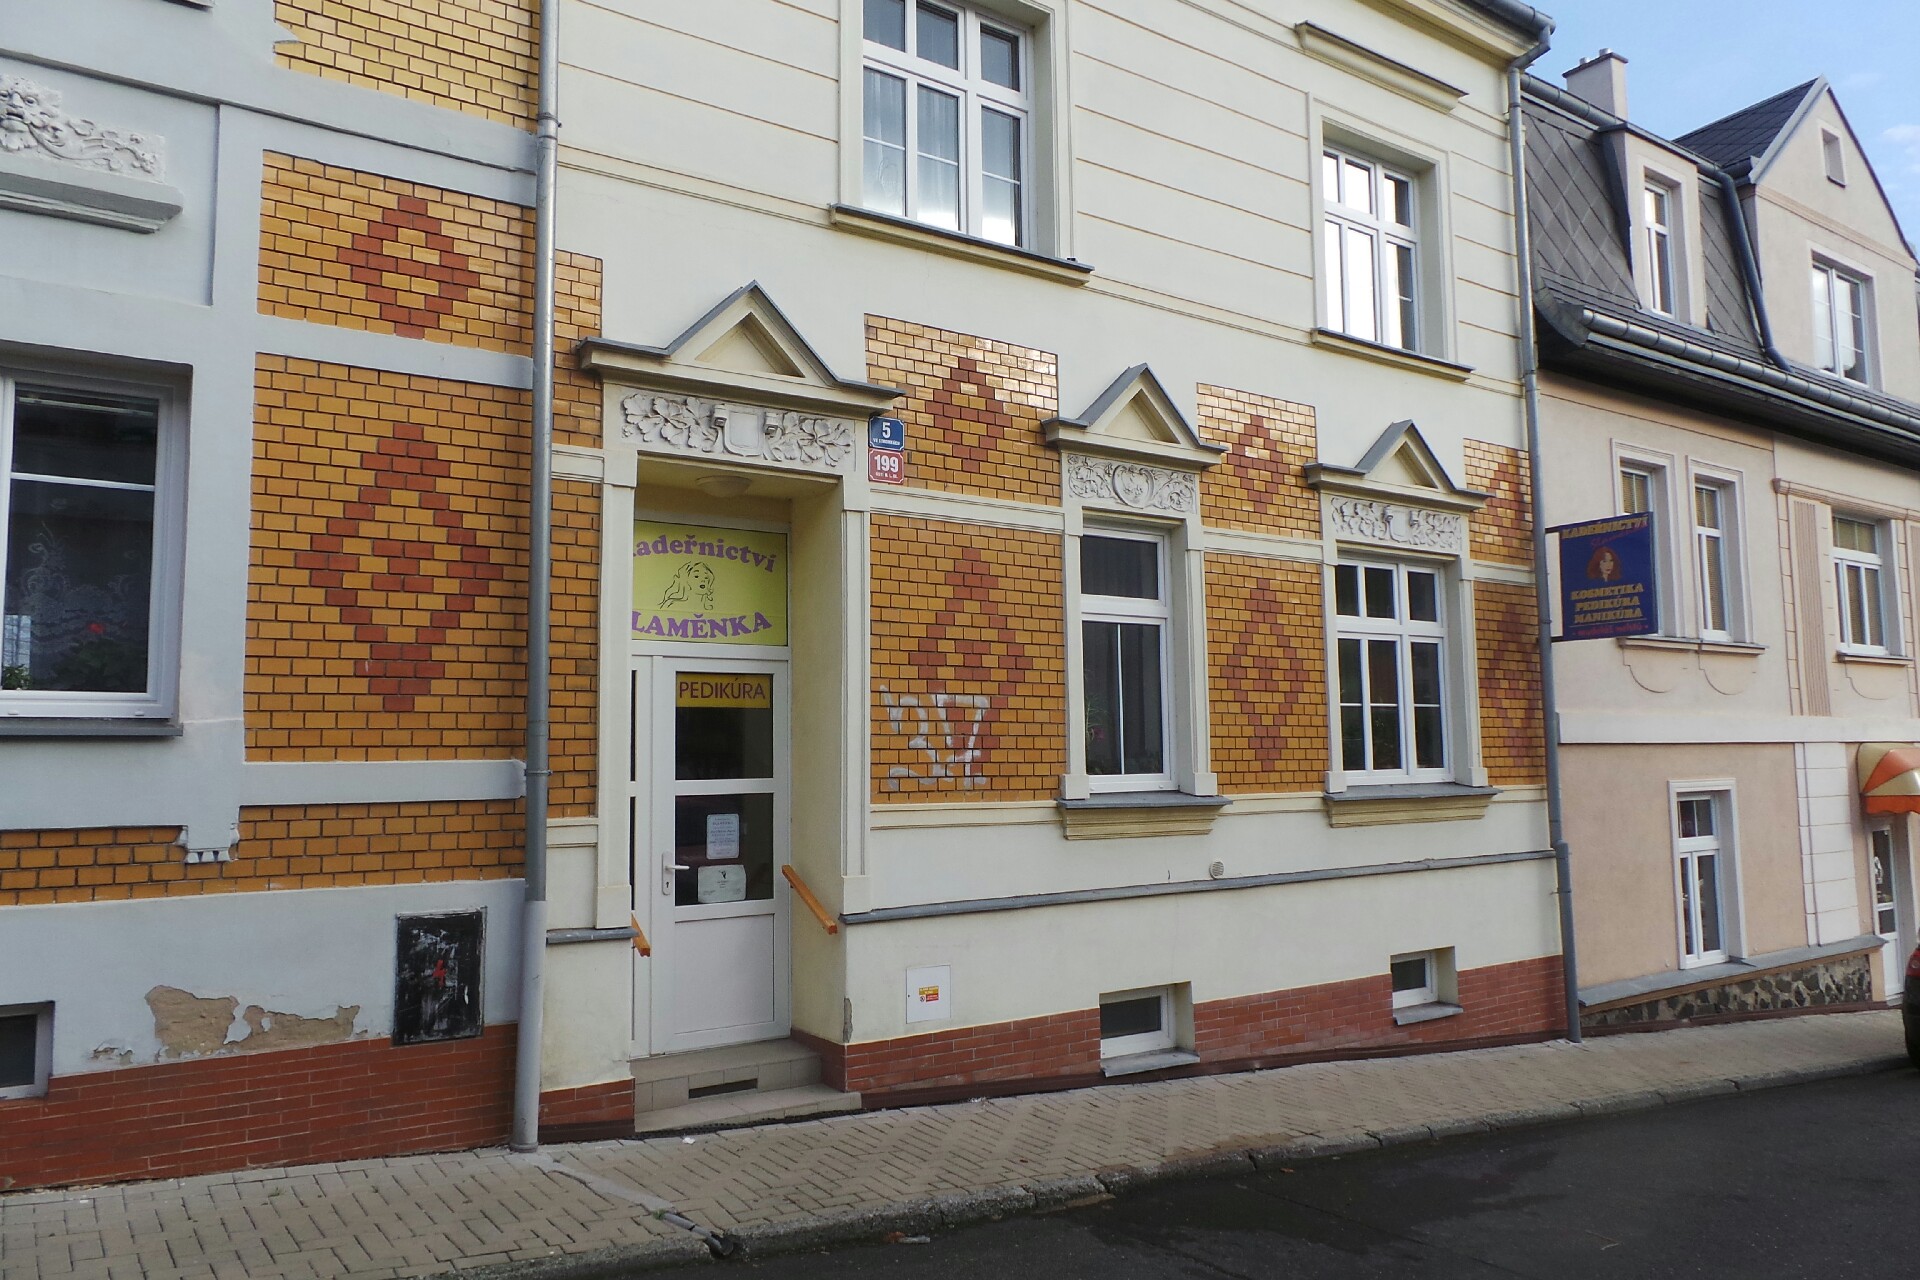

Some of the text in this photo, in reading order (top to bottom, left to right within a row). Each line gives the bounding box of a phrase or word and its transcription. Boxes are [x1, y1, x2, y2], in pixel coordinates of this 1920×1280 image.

[882, 422, 891, 438] 5
[874, 454, 899, 473] 199
[633, 534, 777, 573] adeřnictví
[679, 677, 766, 701] PEDIKÚRA
